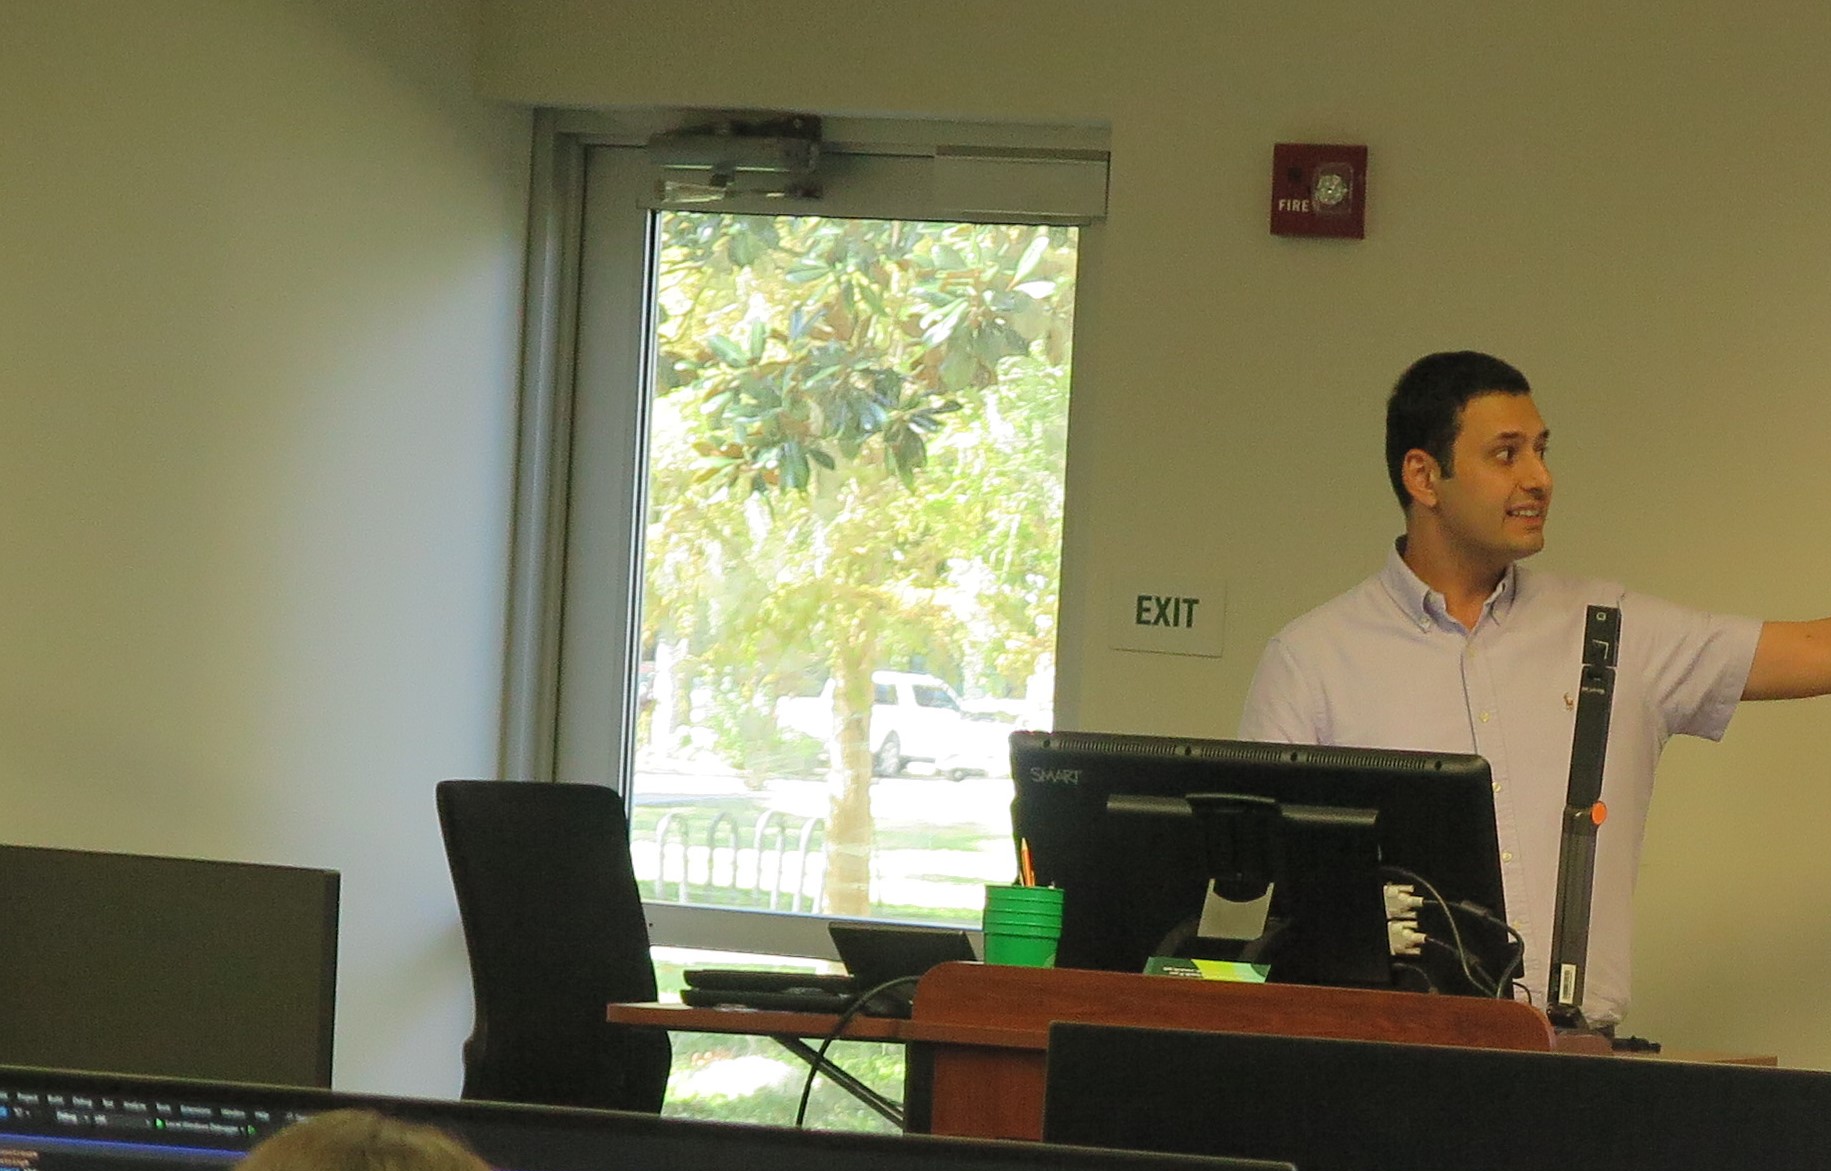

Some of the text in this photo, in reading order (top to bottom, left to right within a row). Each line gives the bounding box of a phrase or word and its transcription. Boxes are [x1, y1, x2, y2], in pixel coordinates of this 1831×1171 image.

[1278, 199, 1310, 213] FIRE
[1136, 595, 1200, 628] EXIT
[1030, 767, 1083, 784] SMART
